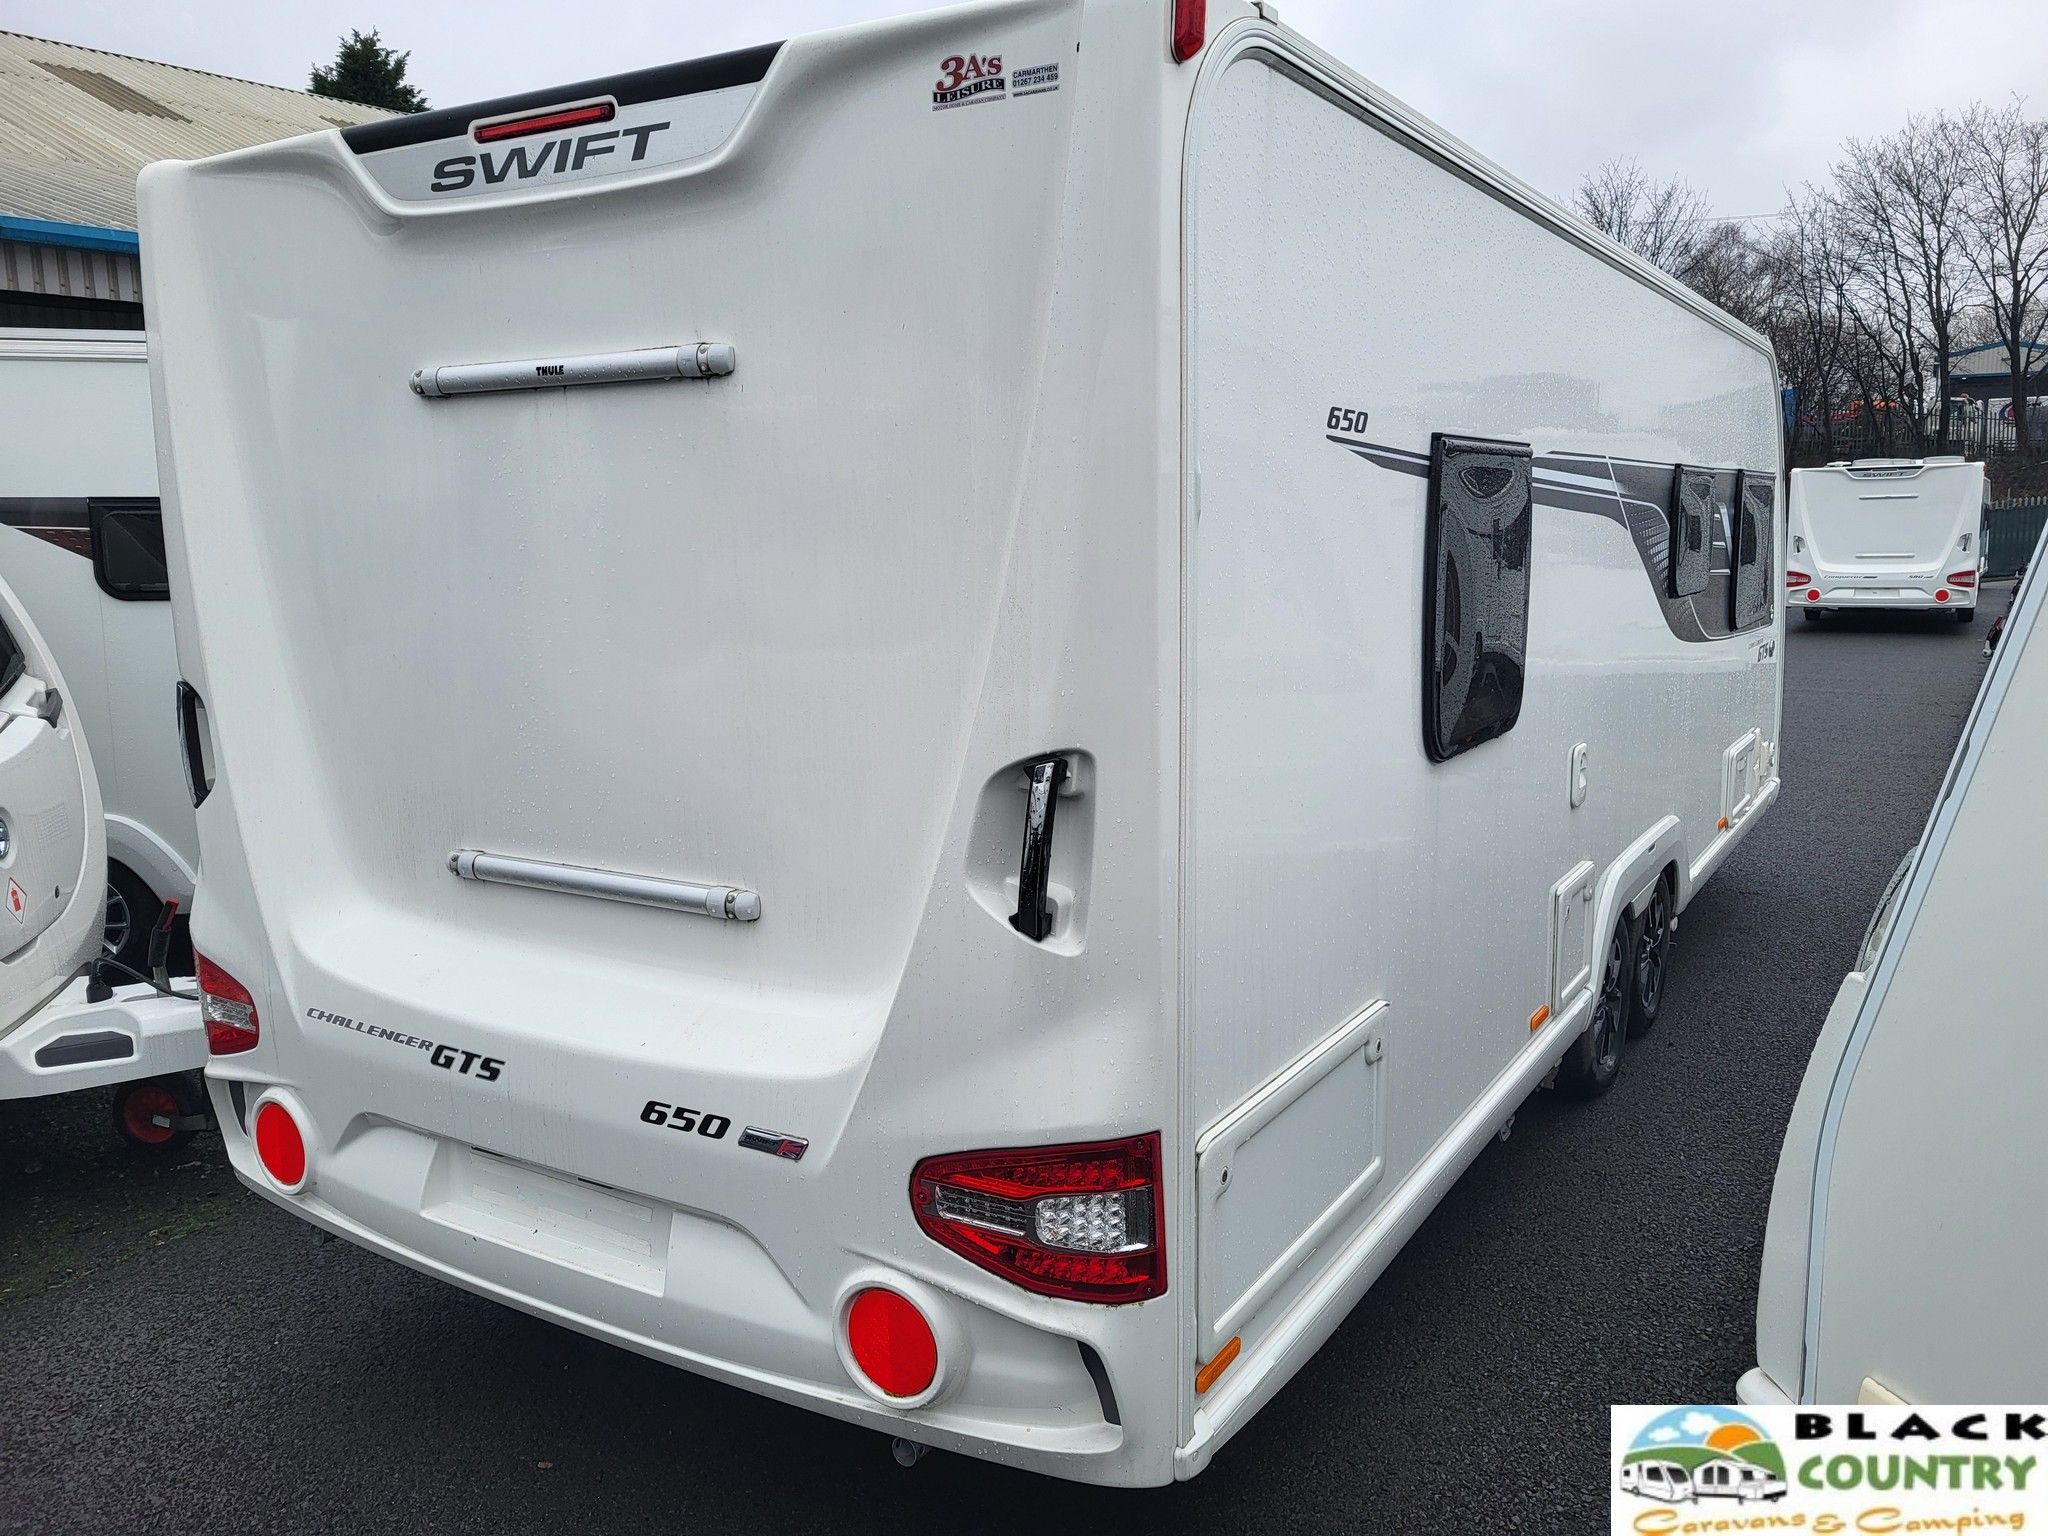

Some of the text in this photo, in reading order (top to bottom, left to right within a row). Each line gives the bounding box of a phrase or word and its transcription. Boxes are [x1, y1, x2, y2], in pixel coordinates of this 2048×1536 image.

[1012, 65, 1058, 79] CARMARTHEN
[1012, 73, 1059, 87] 01267 234 459
[935, 78, 1004, 103] LEISURE
[430, 121, 672, 192] SWIFT
[535, 365, 565, 376] THULE
[1326, 406, 1369, 434] 650
[306, 1007, 506, 1082] CHALLENGER GTS
[640, 1100, 732, 1140] 650
